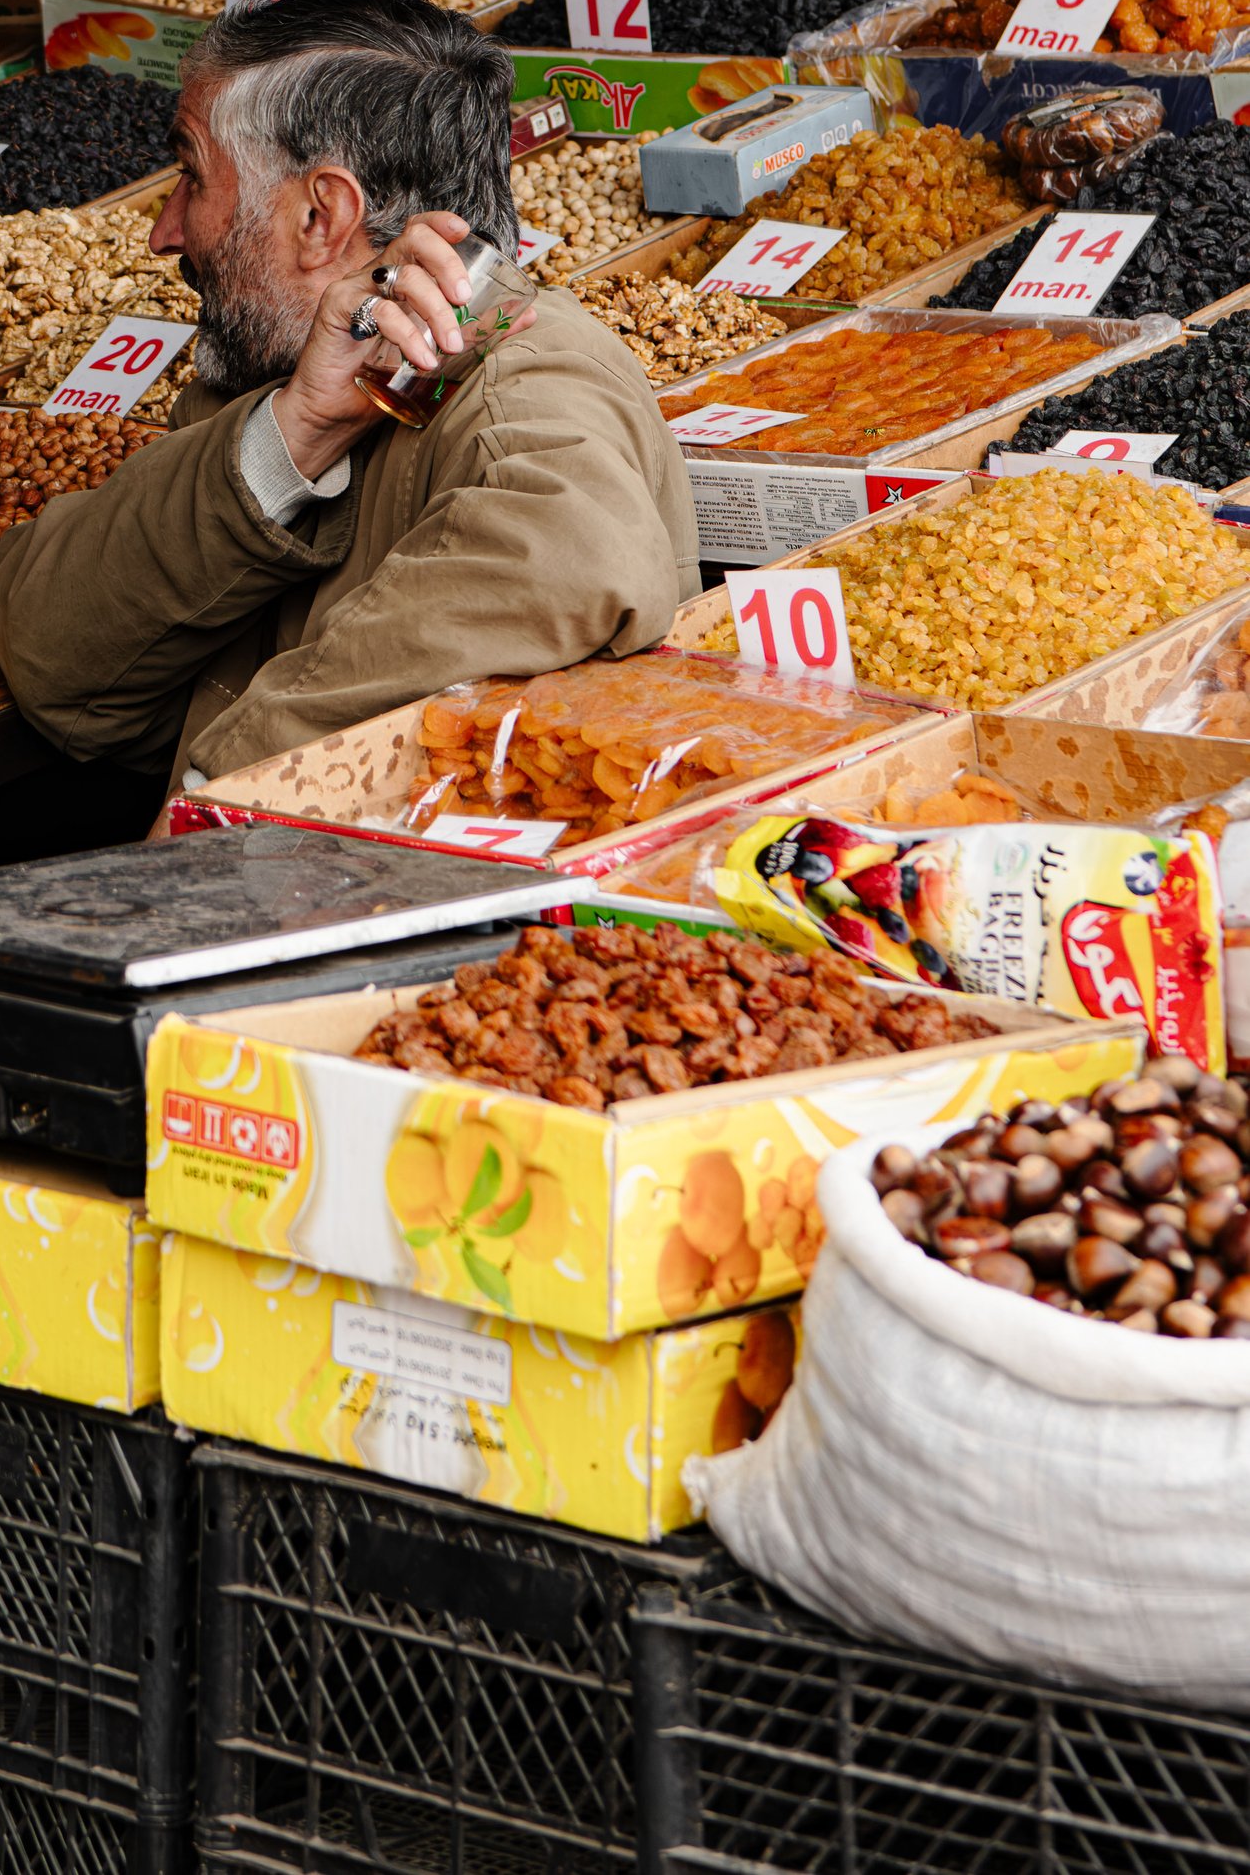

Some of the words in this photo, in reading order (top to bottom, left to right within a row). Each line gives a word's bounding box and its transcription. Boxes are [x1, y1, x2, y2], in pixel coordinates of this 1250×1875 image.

[764, 143, 805, 173] MUSCO
[750, 236, 815, 270] 14
[1054, 228, 1124, 266] 14
[1010, 275, 1093, 301] man.
[90, 334, 164, 376] 20
[54, 383, 123, 413] man.
[703, 411, 775, 426] 11
[739, 587, 838, 668] 10
[214, 1174, 226, 1188] in
[232, 1177, 268, 1200] Made
